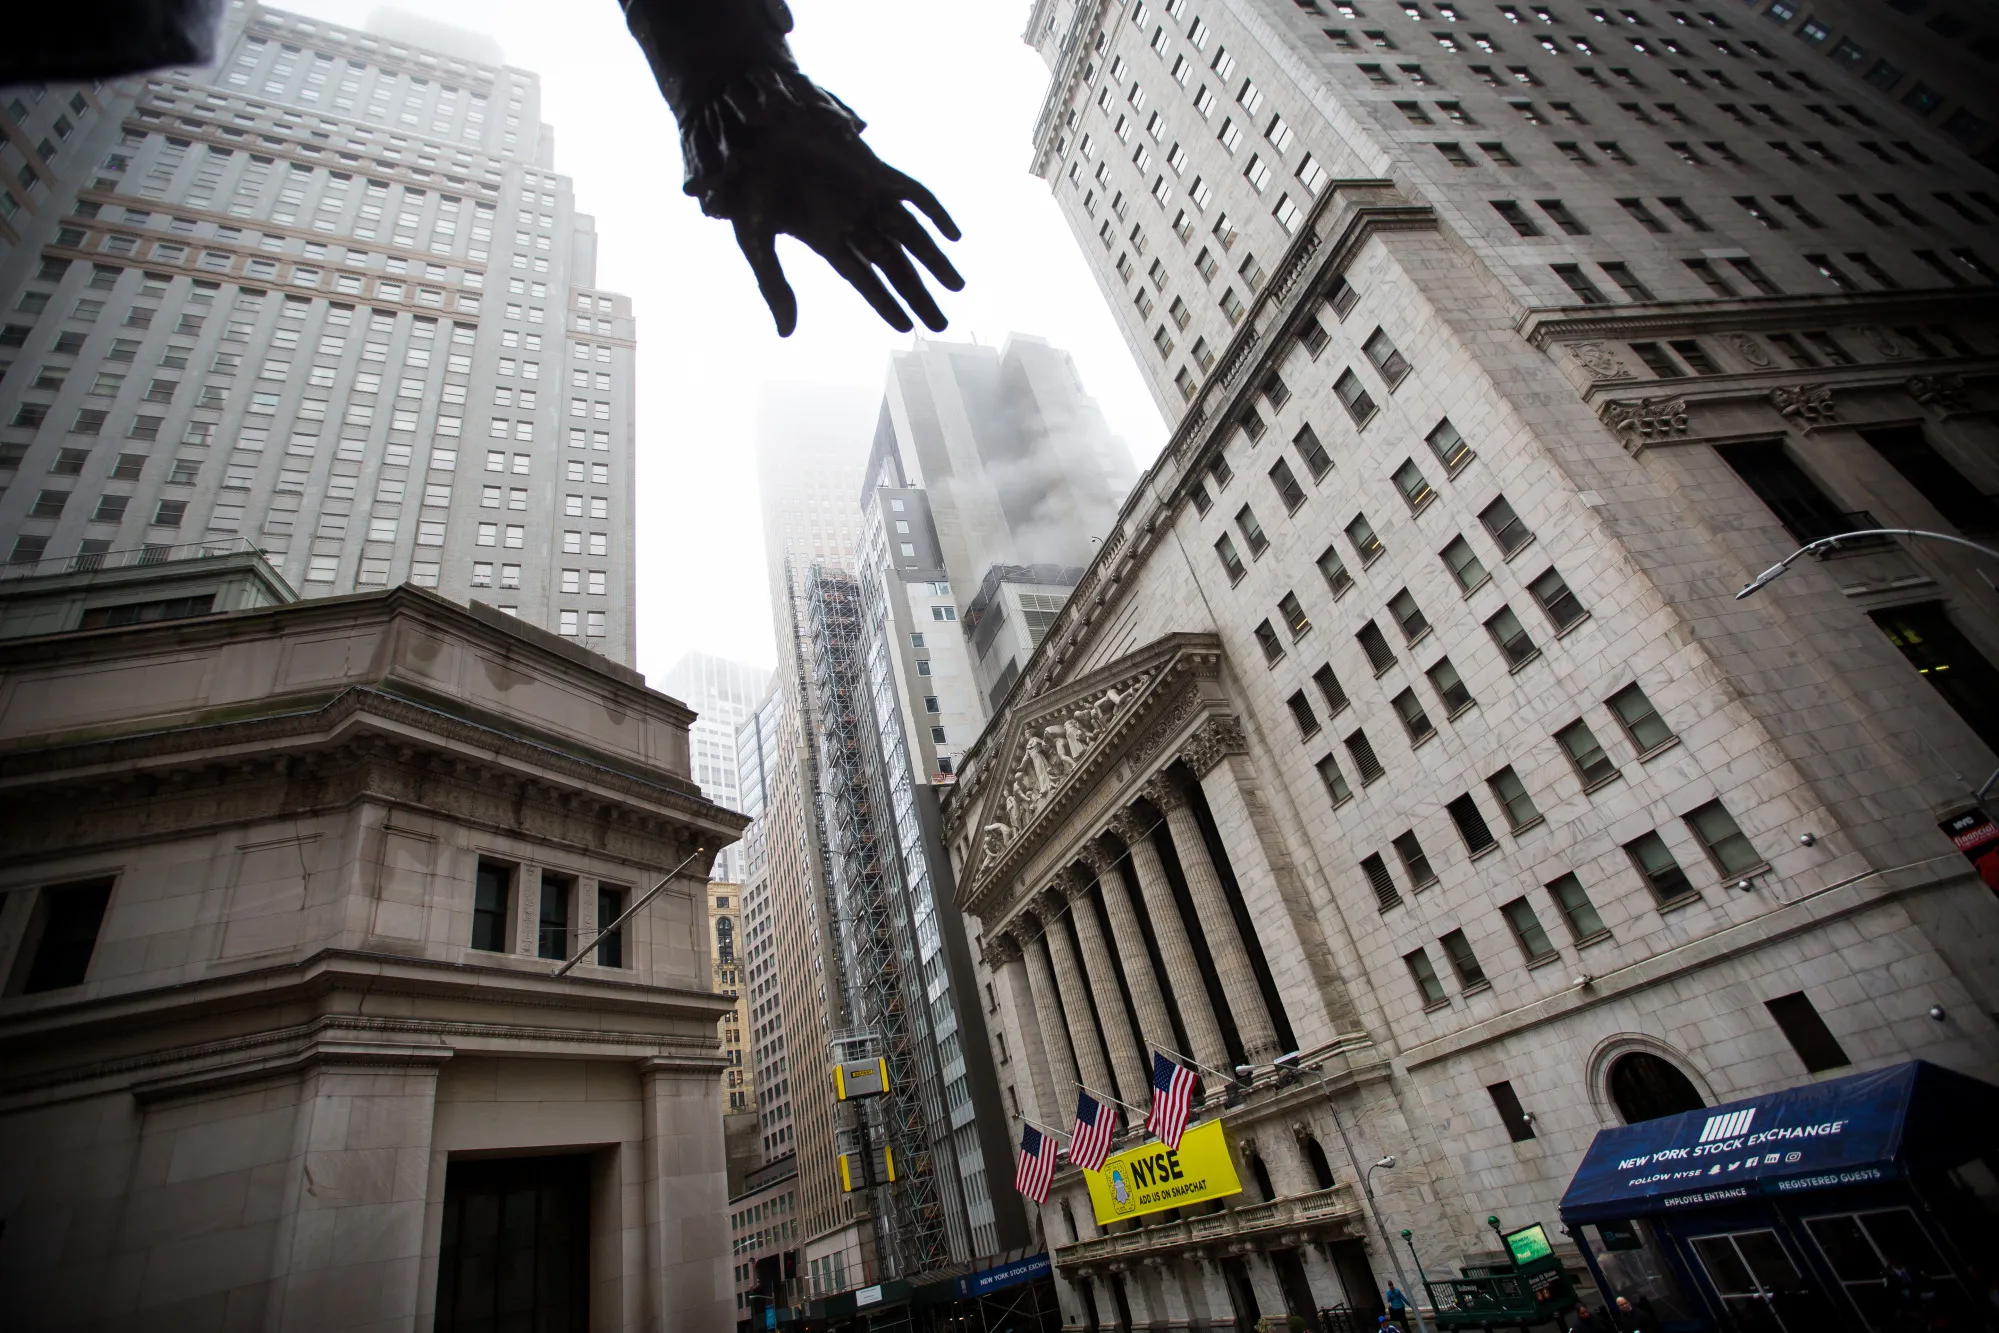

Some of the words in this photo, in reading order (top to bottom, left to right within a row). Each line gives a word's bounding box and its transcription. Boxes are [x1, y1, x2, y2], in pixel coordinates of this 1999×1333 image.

[1618, 1155, 1650, 1171] NEW
[1652, 1147, 1690, 1163] YORK
[1693, 1137, 1745, 1157] STOCK
[1747, 1121, 1843, 1146] EXCHANGE
[1130, 1150, 1184, 1190] NYSE
[1628, 1173, 1671, 1187] FOLLOW
[1673, 1169, 1703, 1179] NYSE
[1778, 1175, 1838, 1190] REGISTERED
[1840, 1168, 1881, 1182] GUESTS
[1139, 1194, 1151, 1205] ADD
[1152, 1191, 1161, 1202] US
[1161, 1188, 1171, 1200] ON
[1172, 1179, 1207, 1197] SNAPCHAT
[1664, 1192, 1703, 1207] EMPLOYEE
[1704, 1188, 1747, 1201] ENTRANCE
[980, 1276, 993, 1286] NEW
[994, 1271, 1009, 1280] YORK
[1009, 1266, 1028, 1277] STOCK
[1456, 1284, 1477, 1292] Subway
